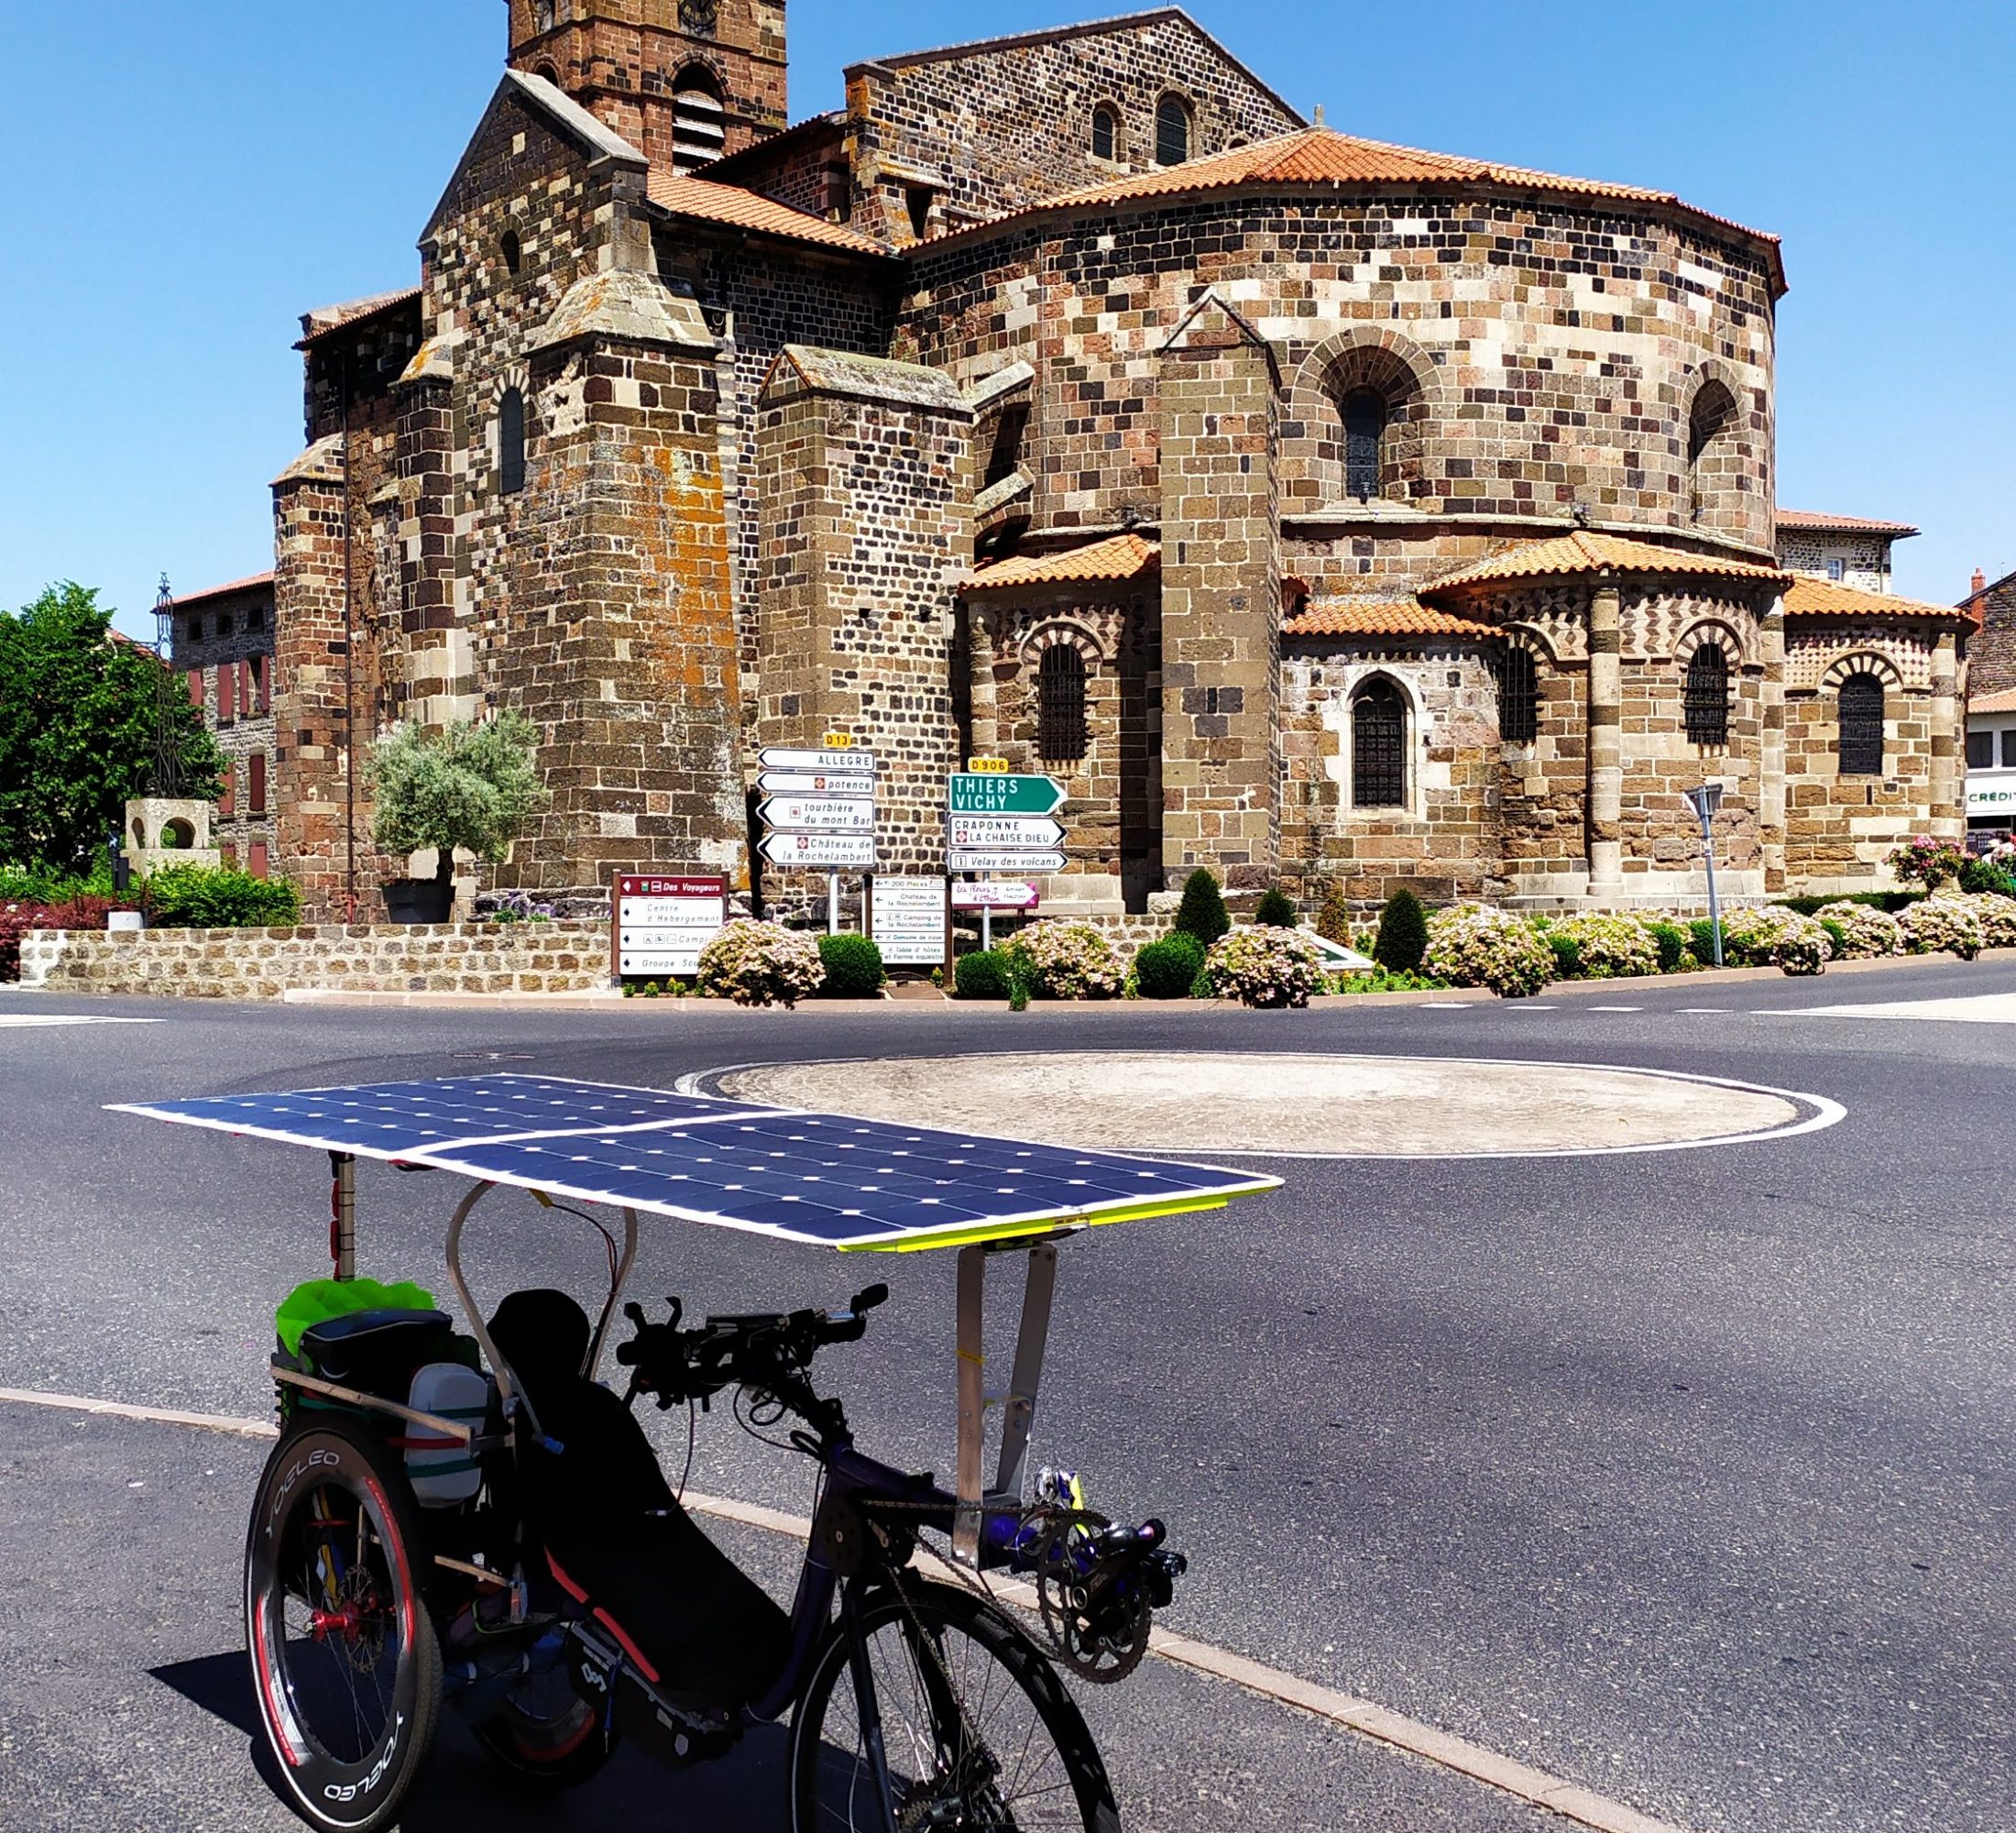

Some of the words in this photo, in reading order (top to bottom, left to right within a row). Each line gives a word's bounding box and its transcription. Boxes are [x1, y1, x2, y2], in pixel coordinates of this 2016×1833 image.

[827, 735, 834, 744] D
[836, 735, 848, 745] 13
[818, 755, 871, 766] ALLEGRE
[972, 762, 979, 770] D
[982, 762, 1005, 771] 906
[827, 780, 871, 791] potence
[955, 778, 1018, 794] THIERS
[955, 794, 1007, 809] VICHY
[805, 803, 854, 813] tourbière
[805, 815, 816, 824] du
[821, 816, 848, 825] mont
[853, 816, 871, 826] Bar
[955, 820, 1020, 830] CRAPONNE
[970, 833, 982, 842] LA
[985, 833, 1023, 842] CHAISE
[1025, 834, 1049, 843] DIEU
[810, 838, 854, 849] Château
[859, 840, 871, 849] de
[783, 851, 792, 860] la
[797, 851, 871, 862] Rochelambert
[970, 857, 997, 867] Velay
[1001, 857, 1017, 866] des
[1021, 857, 1057, 866] volcans
[663, 883, 679, 892] Des
[682, 883, 720, 893] Voyageurs
[647, 904, 679, 912] Centre
[641, 959, 675, 968] Groupe
